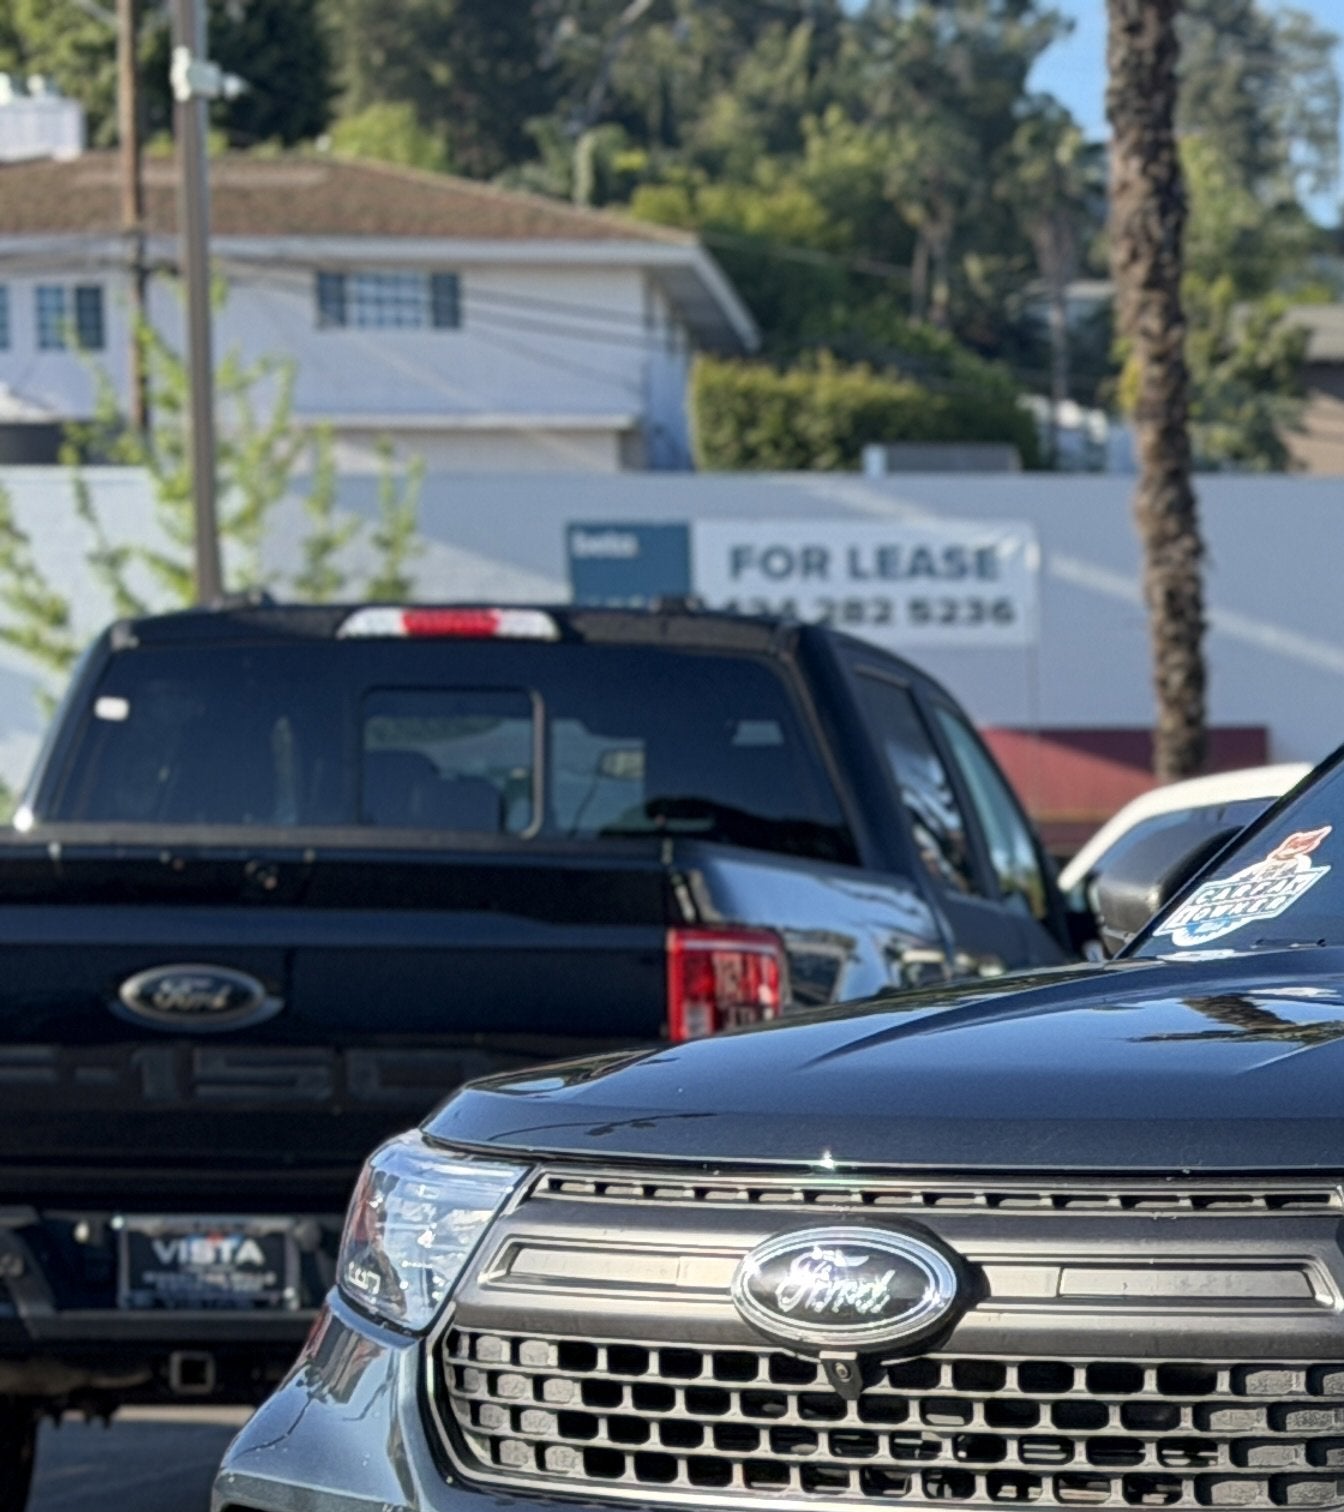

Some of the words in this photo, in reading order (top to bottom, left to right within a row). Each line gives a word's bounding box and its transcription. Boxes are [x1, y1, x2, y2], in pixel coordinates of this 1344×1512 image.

[730, 545, 830, 582] FOR
[849, 545, 999, 582] LEASE
[1195, 874, 1309, 905] CARFAX
[152, 1238, 266, 1266] VISTA
[776, 1245, 896, 1314] Ford
